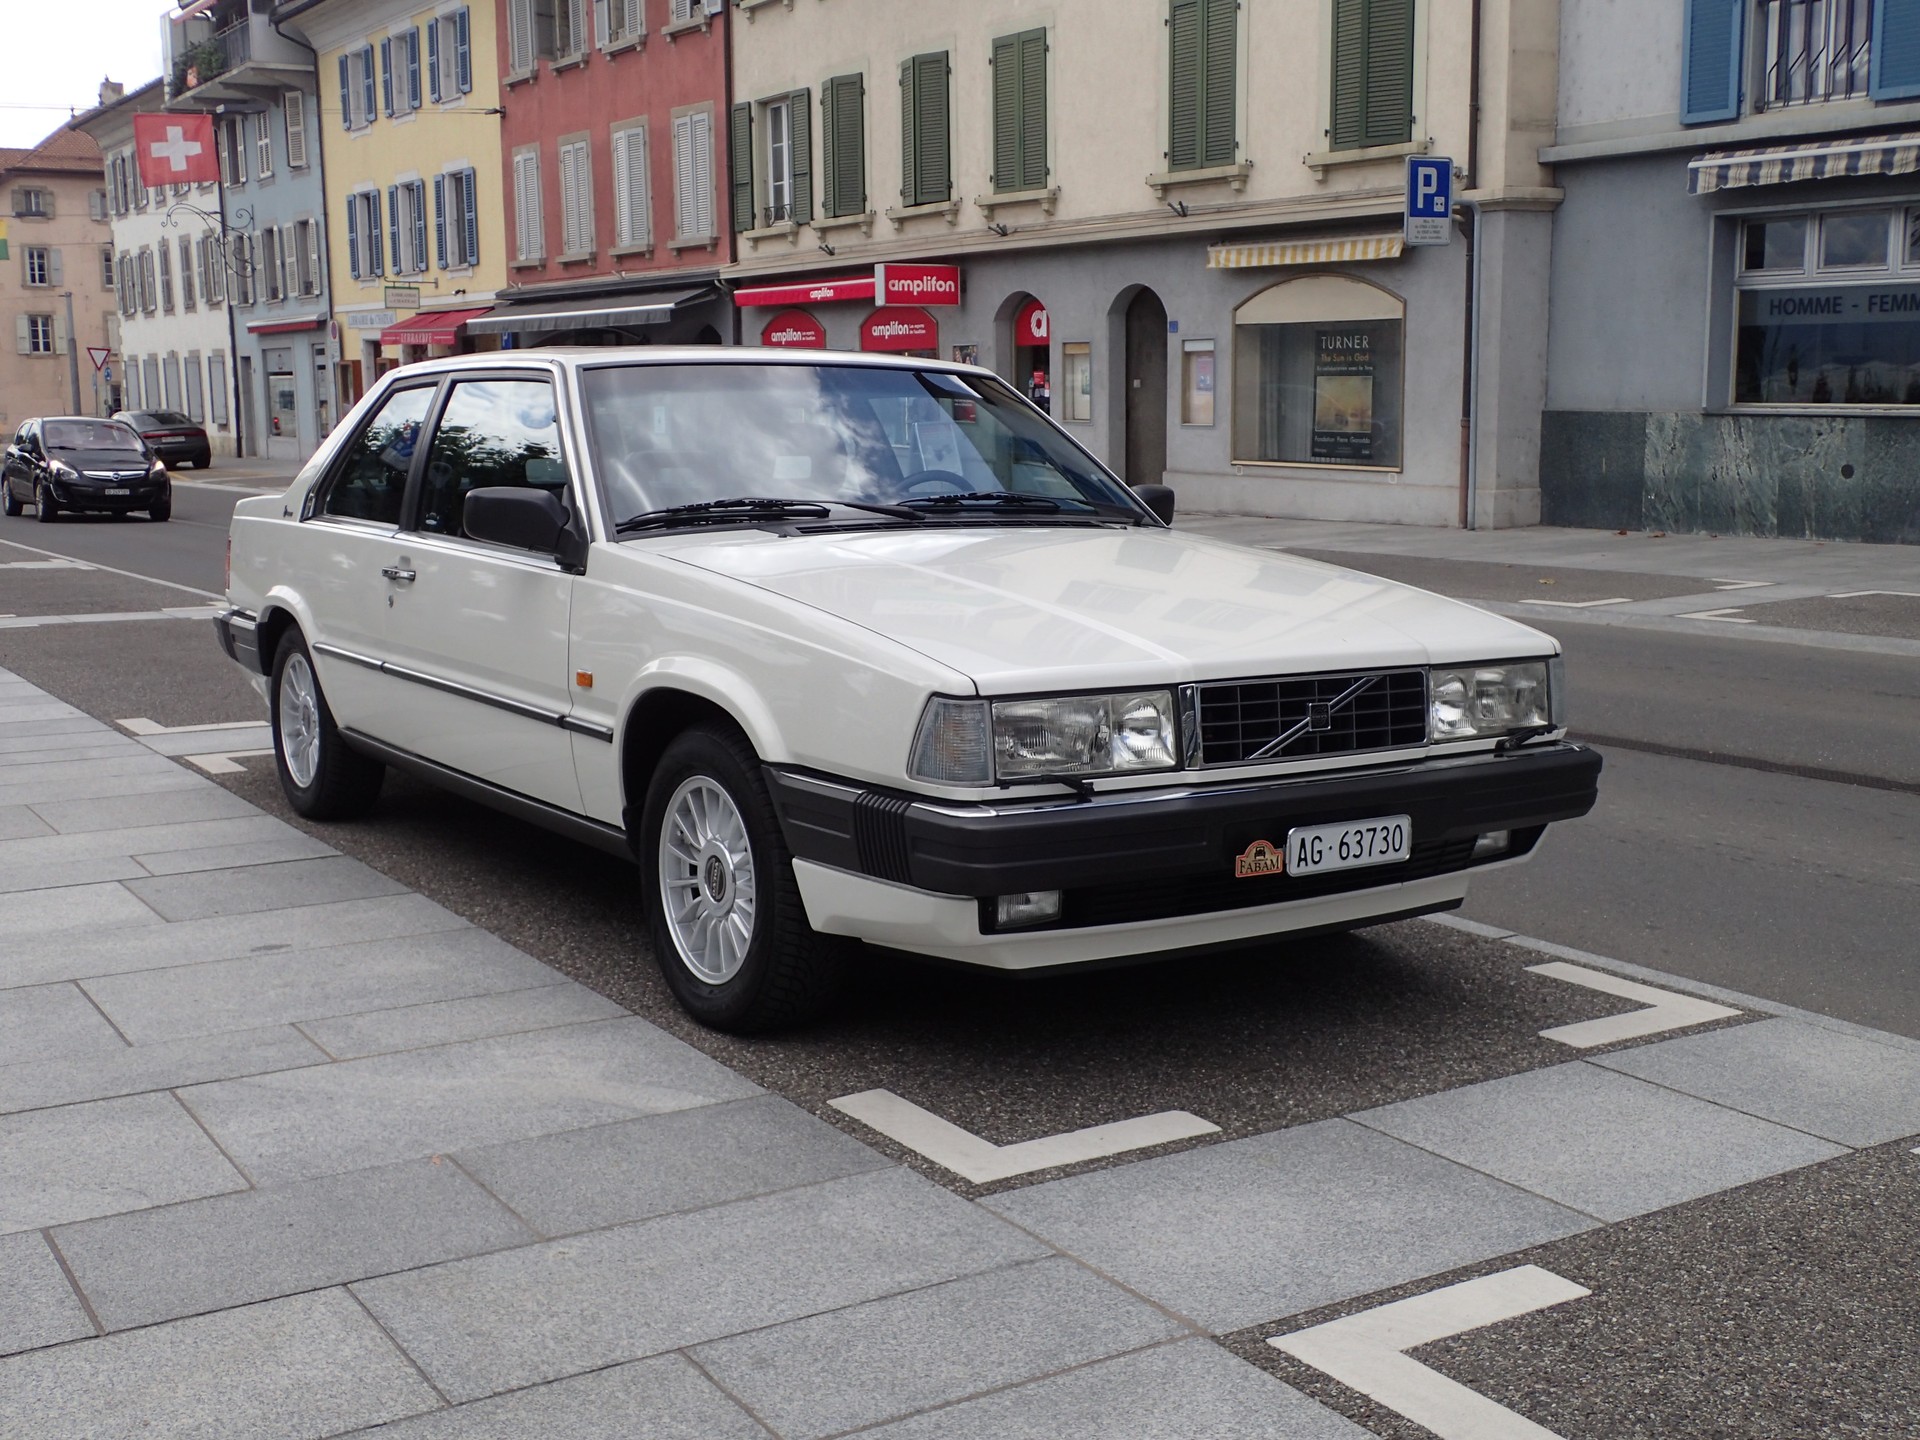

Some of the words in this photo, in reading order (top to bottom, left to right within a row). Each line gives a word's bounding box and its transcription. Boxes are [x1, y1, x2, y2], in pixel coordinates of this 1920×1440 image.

[1417, 166, 1438, 209] P
[810, 286, 834, 300] amplifon
[888, 275, 955, 296] amplifon
[1769, 296, 1843, 316] HOMME
[771, 327, 802, 345] amplifon
[871, 320, 909, 339] amplifon
[1321, 335, 1369, 350] TURNER
[1354, 352, 1369, 362] God
[1239, 855, 1280, 874] FABAM
